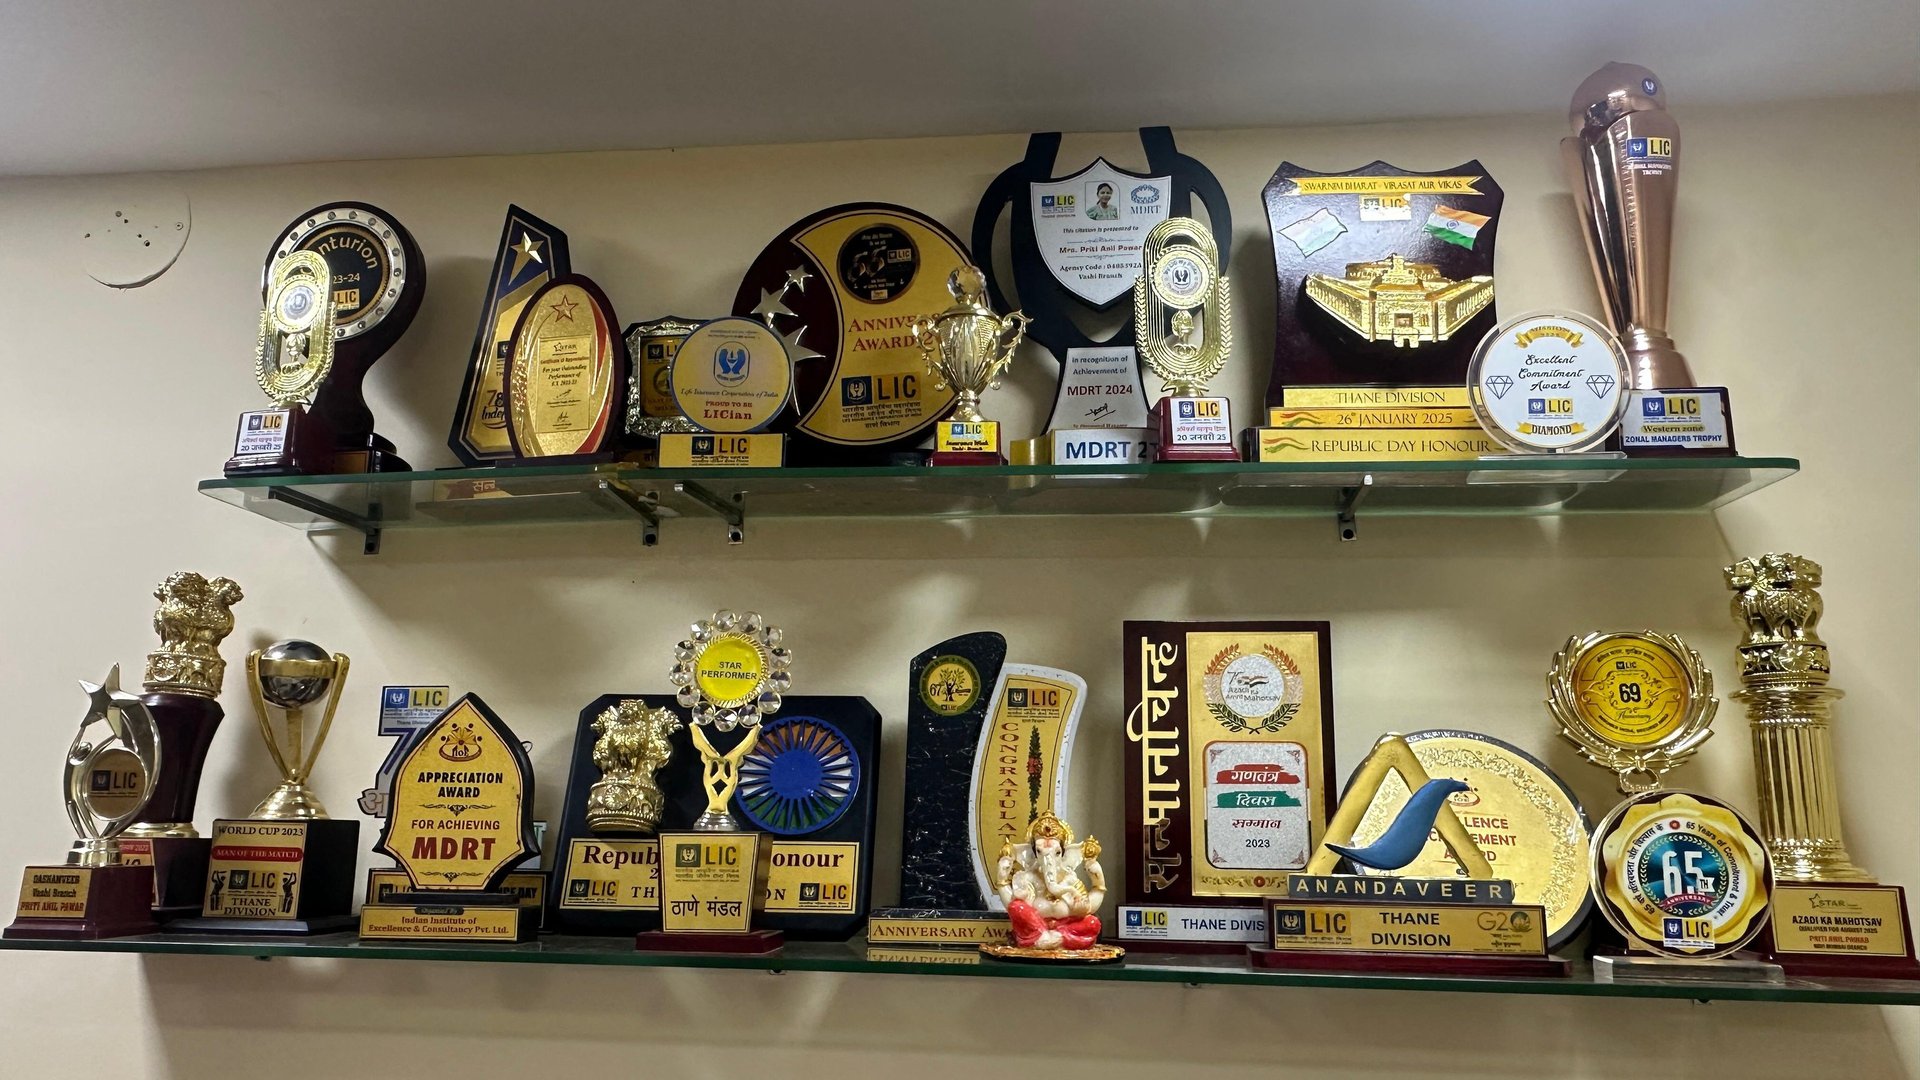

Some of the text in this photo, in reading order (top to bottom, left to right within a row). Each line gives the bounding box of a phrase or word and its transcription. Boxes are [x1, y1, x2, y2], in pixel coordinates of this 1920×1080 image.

[1650, 138, 1670, 156] LIC
[1383, 182, 1416, 190] VIRASAT
[1418, 181, 1435, 190] AUR
[1437, 181, 1463, 190] VIKAS
[1057, 195, 1075, 206] LIC
[1130, 205, 1161, 216] MDRT
[318, 236, 378, 269] nturion
[1060, 263, 1102, 273] Agency Code
[333, 272, 361, 285] 23-24
[336, 290, 357, 304] LIC
[852, 335, 916, 352] AWARD
[1080, 356, 1118, 365] recognition
[1120, 354, 1128, 362] of
[1525, 354, 1578, 366] Excellent
[1073, 366, 1127, 376] Achievement of
[1517, 367, 1586, 379] Commitment
[877, 375, 917, 401] LIC
[1066, 384, 1133, 397] MDRT 2024
[1530, 380, 1571, 392] Award
[1336, 391, 1445, 404] THANE DIVISION
[1197, 401, 1218, 417] LIC
[1548, 399, 1570, 413] LIC
[1668, 398, 1697, 415] LIC
[263, 414, 282, 429] LIC
[703, 409, 752, 420] LICian
[1357, 412, 1453, 427] JANUARY 2025
[965, 424, 982, 435] LIC
[1177, 431, 1227, 442] 20 जनवरी 25
[1531, 424, 1572, 436] DIAMOND
[1642, 425, 1705, 434] Western zone
[718, 437, 748, 454] LIC
[1311, 439, 1490, 452] REPUBLIC DAY HONOUR
[1625, 434, 1722, 443] ZONAL MANAGERS TROPHY
[240, 444, 250, 452] 20
[1065, 440, 1132, 459] MDRT
[718, 661, 742, 670] STAR
[1625, 661, 1637, 669] LIC
[701, 670, 757, 682] PERFORMER
[930, 683, 943, 696] 67
[1618, 682, 1642, 704] 69
[413, 690, 442, 707] LIC
[1031, 690, 1058, 706] LIC
[113, 771, 138, 790] LIC
[417, 772, 504, 785] APPRECIATION
[1231, 766, 1280, 784] गणतंत्र
[437, 786, 481, 799] AWARD
[1235, 792, 1277, 807] दिवस
[411, 819, 501, 831] FOR ACHIEVING
[1231, 817, 1282, 831] सम्मान
[1465, 816, 1509, 830] LENCE
[1685, 820, 1696, 830] 65
[218, 825, 304, 837] WORLD CUP 2023
[1697, 823, 1716, 841] Years
[1245, 835, 1271, 847] 2023
[1716, 838, 1725, 848] of
[216, 849, 299, 860] MAN OF THE MATCH
[411, 837, 496, 861] MDRT
[705, 846, 738, 866] LIC
[582, 845, 658, 869] Repub
[771, 853, 845, 869] onour
[1662, 849, 1710, 898] 65
[1723, 845, 1741, 893] Commitment
[250, 871, 276, 889] LIC
[591, 880, 618, 898] LIC
[822, 884, 848, 900] LIC
[1296, 878, 1504, 899] ANANDAVEER
[231, 897, 272, 907] THANE
[671, 894, 743, 917] ठाणे मंडल
[1718, 900, 1736, 918] Trust
[1818, 898, 1846, 908] STAR
[223, 907, 277, 917] DIVISION
[1144, 911, 1166, 926] LIC
[1379, 911, 1440, 926] THANE
[401, 916, 429, 924] Indian
[430, 916, 467, 924] Institute
[1181, 918, 1226, 933] THANE
[1229, 919, 1265, 933] DIVIS
[1311, 913, 1347, 935] LIC
[1792, 915, 1883, 926] AZADI KA MAHOTSAV
[368, 924, 509, 935] Excellence & Consultancy Pvt. Ltd.
[872, 926, 976, 943] ANNIVERSARY
[1684, 920, 1710, 939] LIC
[1371, 932, 1452, 947] DIVISION
